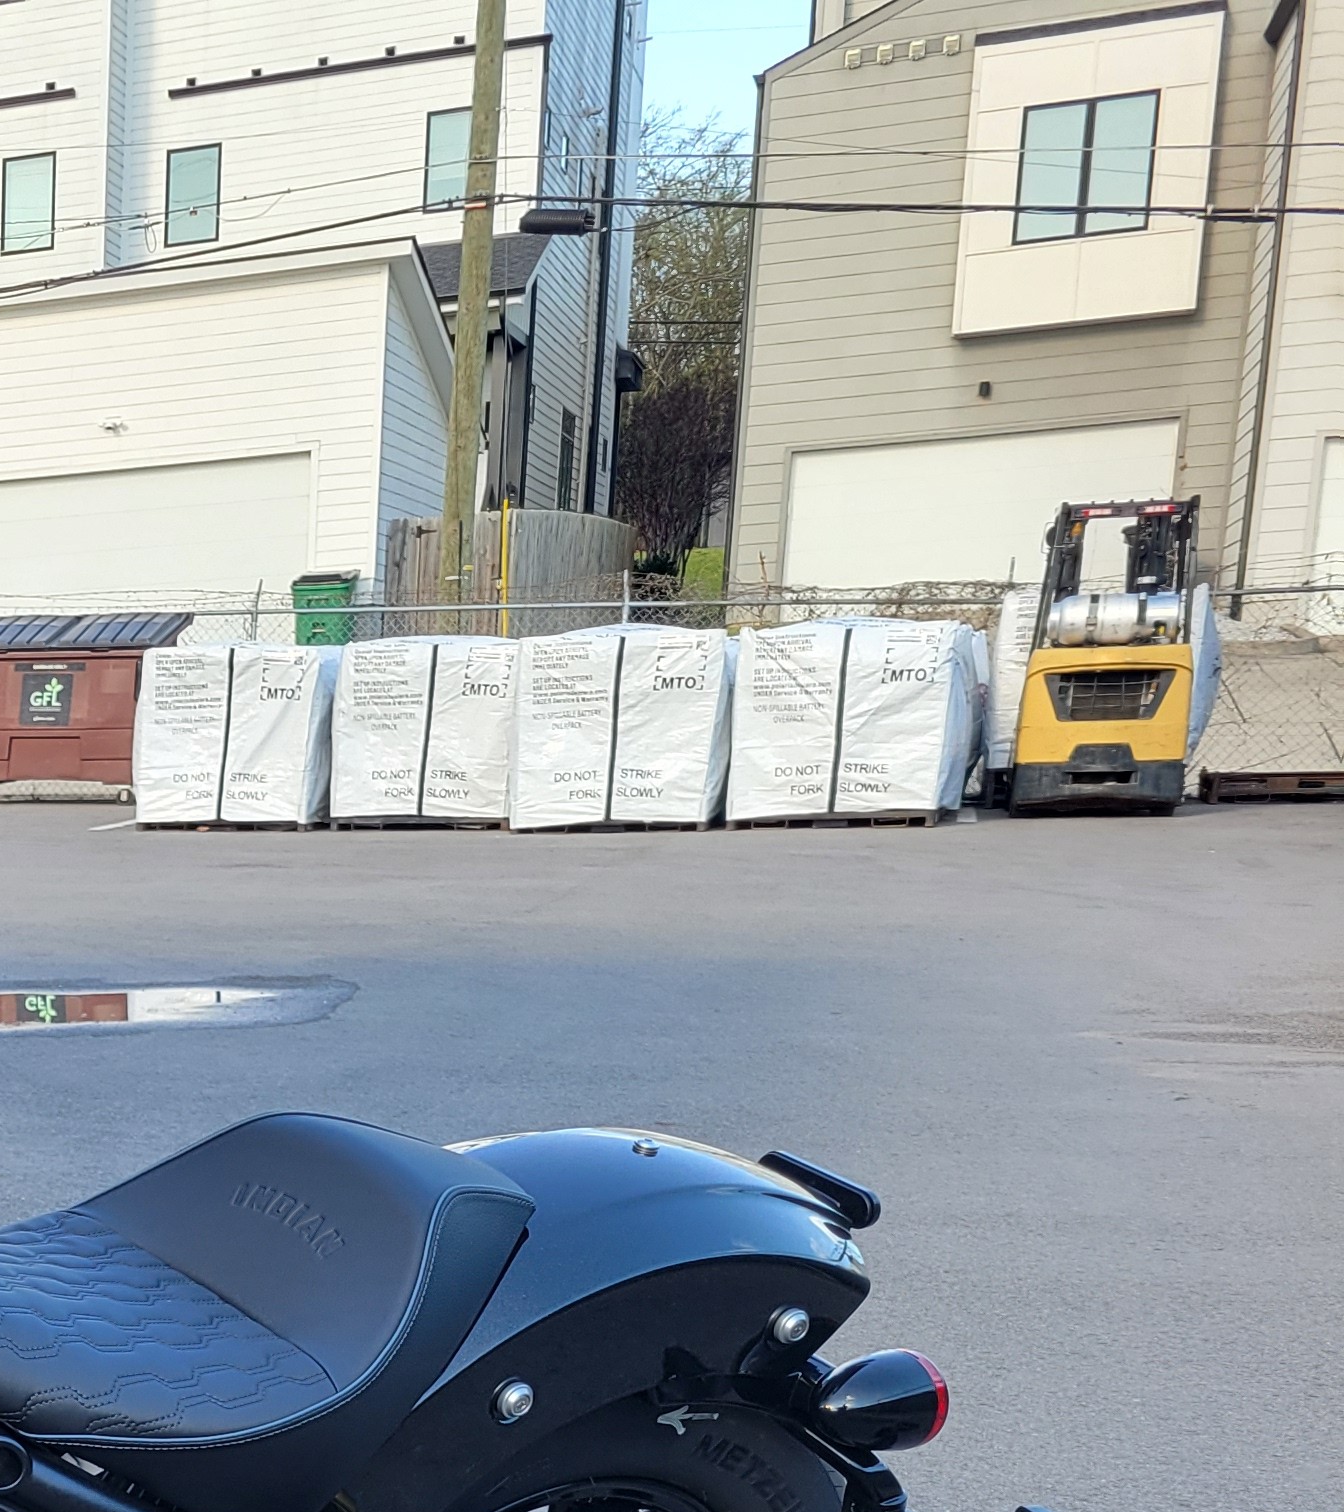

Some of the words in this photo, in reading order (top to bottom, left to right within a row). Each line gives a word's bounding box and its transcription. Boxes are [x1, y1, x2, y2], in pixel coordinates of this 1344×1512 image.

[371, 770, 387, 780] DO
[389, 769, 413, 779] NOT
[620, 768, 664, 780] STRIKE
[774, 767, 792, 777] DO
[795, 764, 822, 776] NOT
[843, 763, 890, 774] STRIKE
[229, 772, 268, 784] STRIKE
[430, 769, 468, 781] STRIKE
[554, 773, 571, 783] DO
[573, 770, 598, 781] NOT
[384, 787, 415, 798] FORK
[426, 788, 470, 799] SLOWLY
[615, 787, 664, 799] SLOWLY
[790, 783, 824, 796] FORK
[839, 782, 892, 793] SLOWLY
[225, 790, 268, 801] SLOWLY
[569, 789, 602, 800] FORK
[230, 1182, 346, 1260] INDIAN
